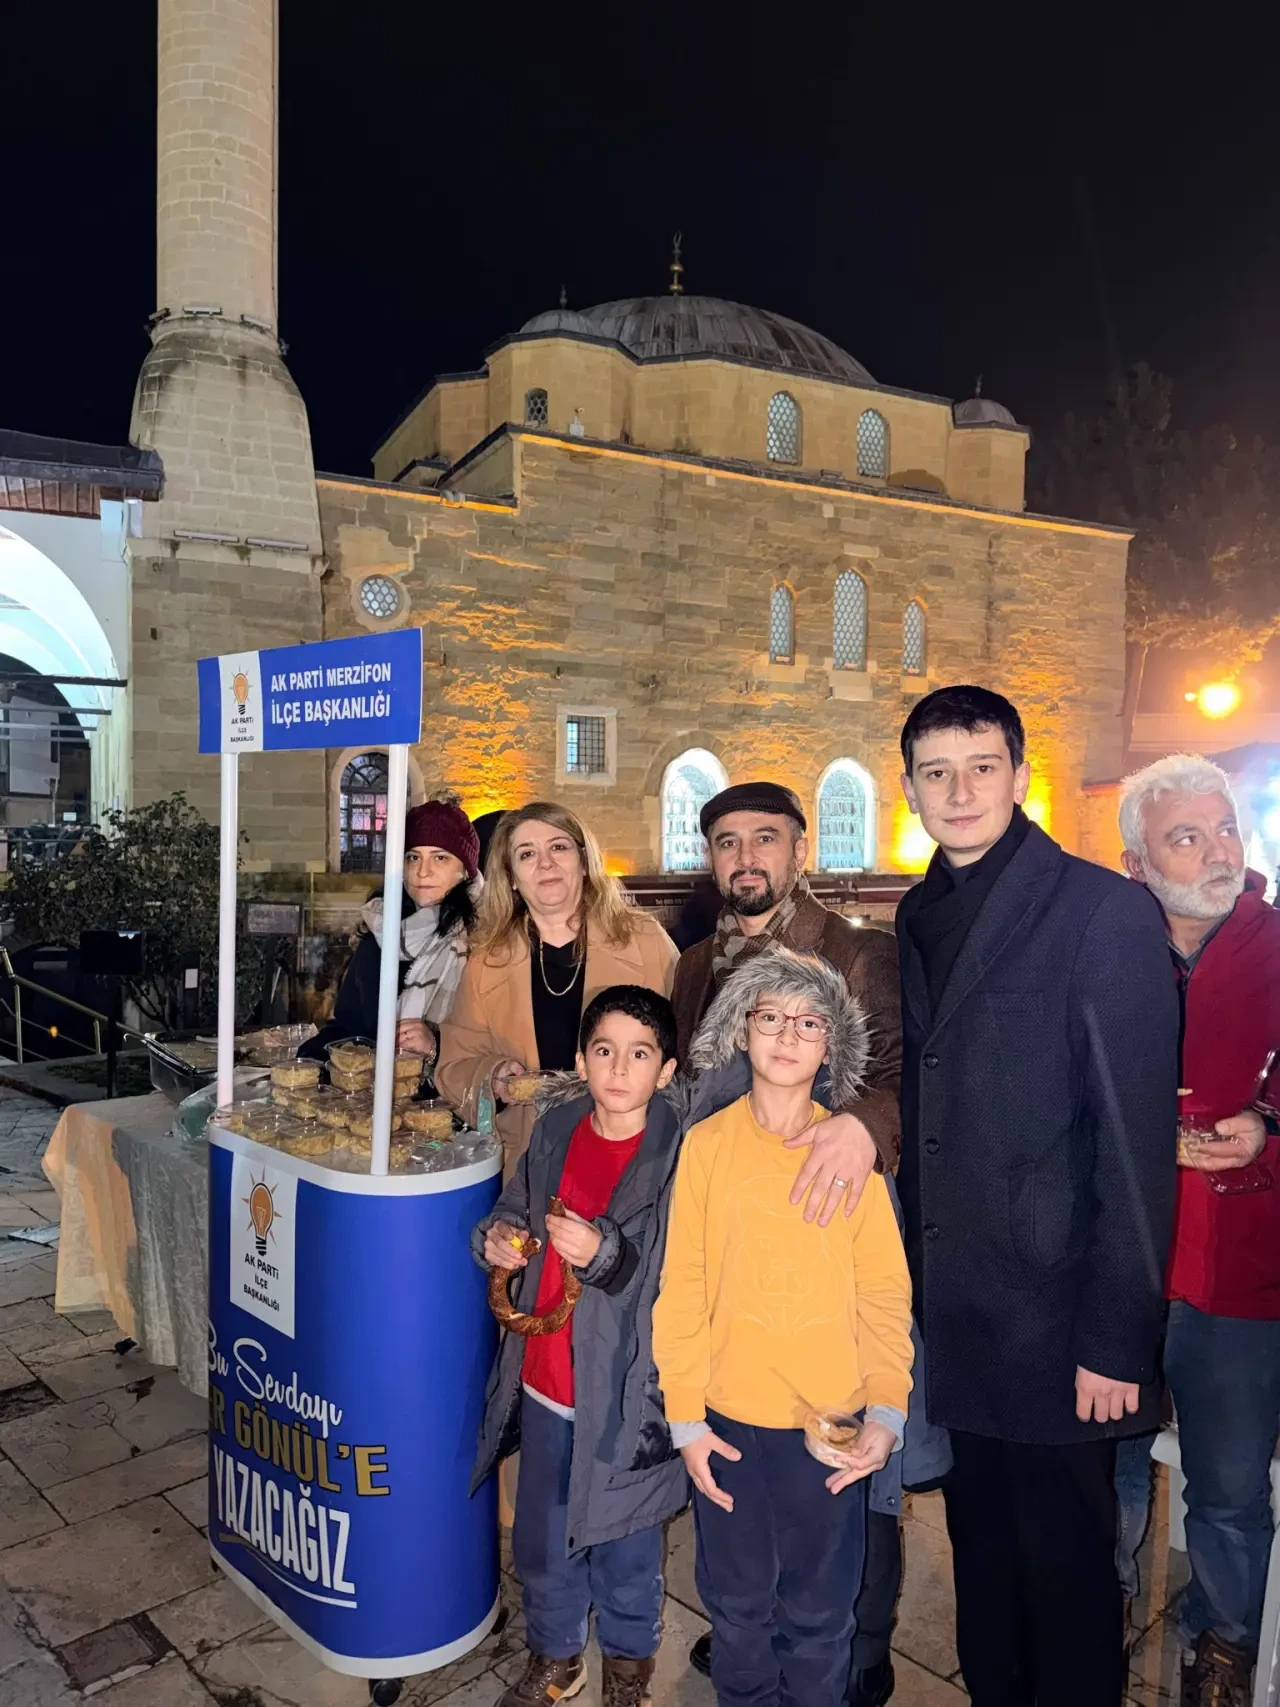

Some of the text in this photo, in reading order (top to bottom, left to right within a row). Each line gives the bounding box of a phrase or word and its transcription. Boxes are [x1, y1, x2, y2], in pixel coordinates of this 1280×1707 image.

[271, 660, 391, 692] AK PARTİ MERZİFON
[271, 689, 391, 729] İLÇE BAŞKANLIĞI
[244, 1252, 279, 1280] AK PARTİ
[254, 1272, 268, 1290] İLÇE
[243, 1283, 280, 1312] BAŞKANLIĞI
[208, 1319, 229, 1377] Bu
[213, 1444, 356, 1595] YAZACAĞIZ
